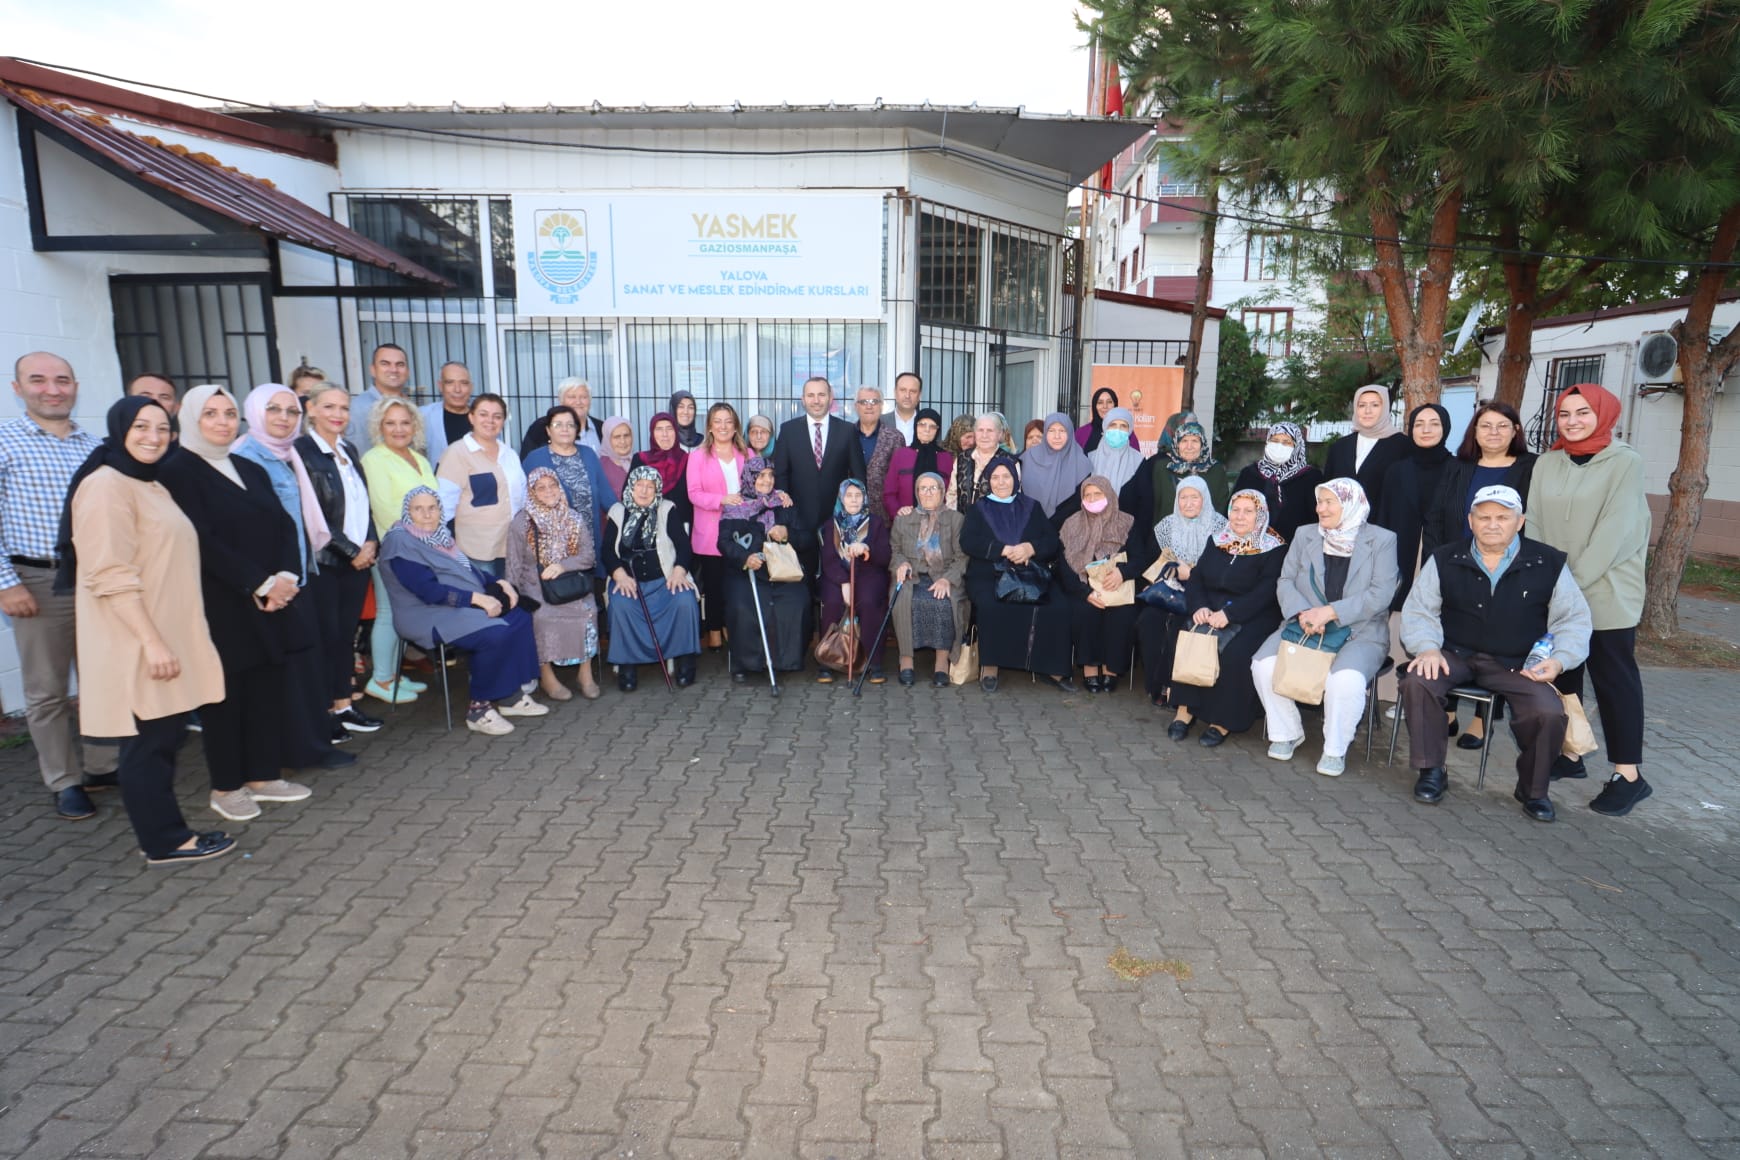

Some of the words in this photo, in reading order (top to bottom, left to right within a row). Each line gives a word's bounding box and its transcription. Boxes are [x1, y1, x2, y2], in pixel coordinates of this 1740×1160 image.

[691, 213, 798, 239] YASMEK
[699, 242, 797, 255] GAZİOSMANPAŞA
[720, 270, 769, 281] YALOVA
[623, 284, 665, 295] SANAT
[668, 284, 686, 295] VE
[688, 284, 736, 296] MESLEK
[738, 282, 805, 296] EDİNDİRME
[807, 284, 869, 296] KURSLARI
